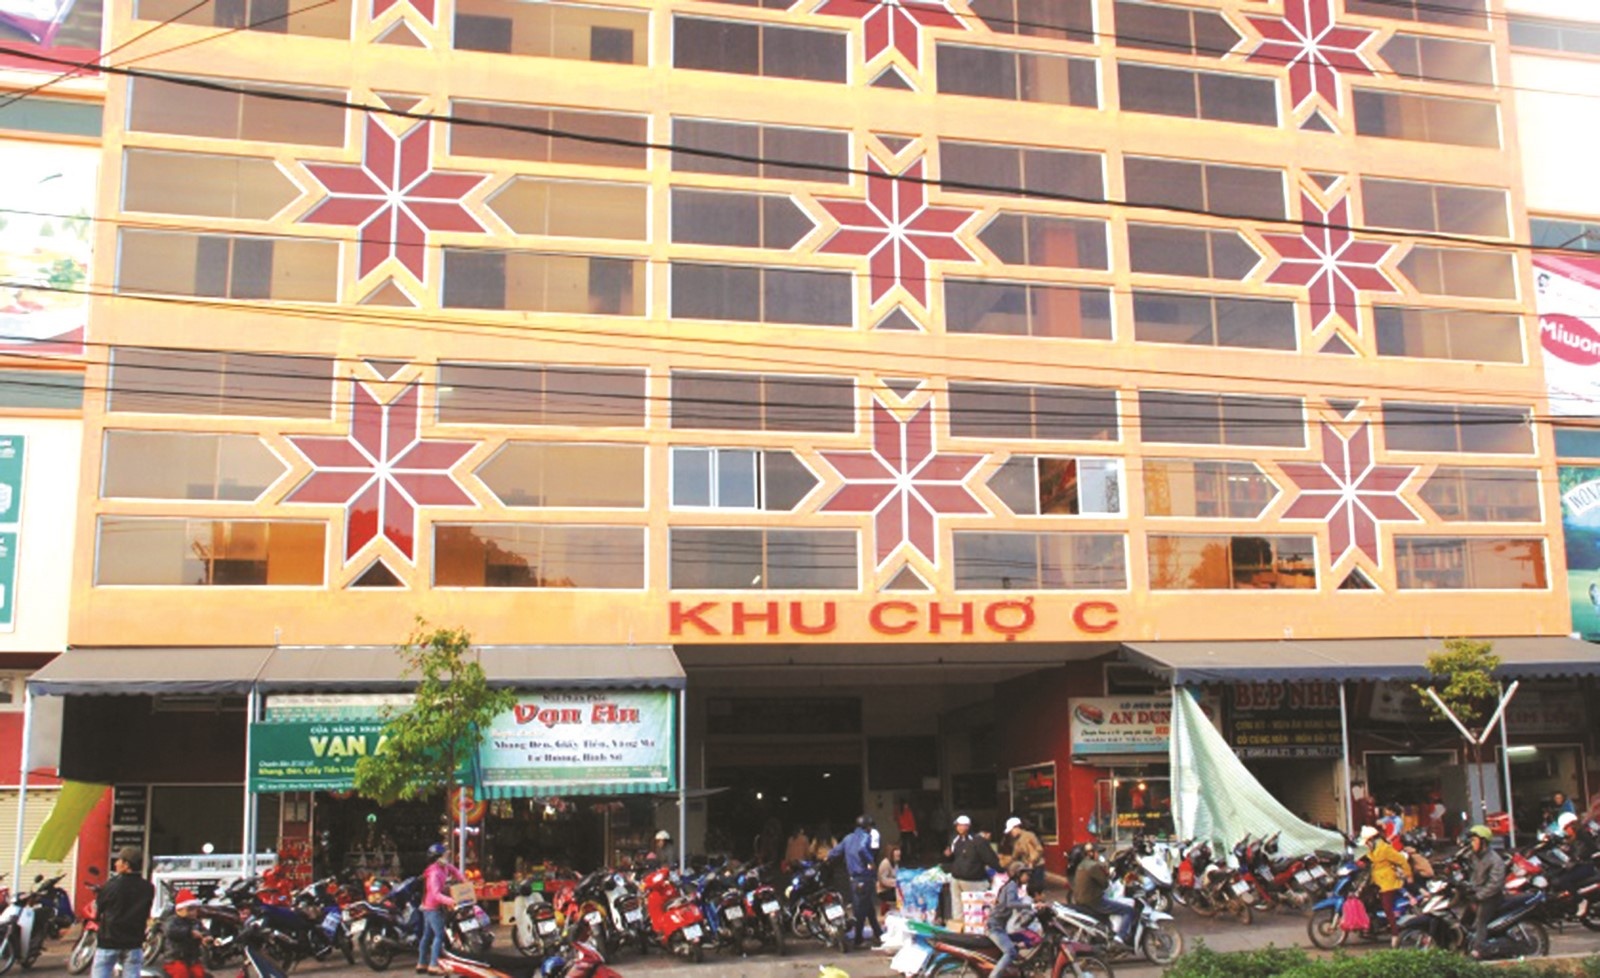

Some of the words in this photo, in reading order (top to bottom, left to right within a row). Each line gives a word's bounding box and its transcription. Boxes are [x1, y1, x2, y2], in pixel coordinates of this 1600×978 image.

[668, 601, 837, 636] KHU
[868, 596, 1036, 642] CHỢ
[1072, 601, 1119, 634] C
[309, 735, 367, 762] VẠN
